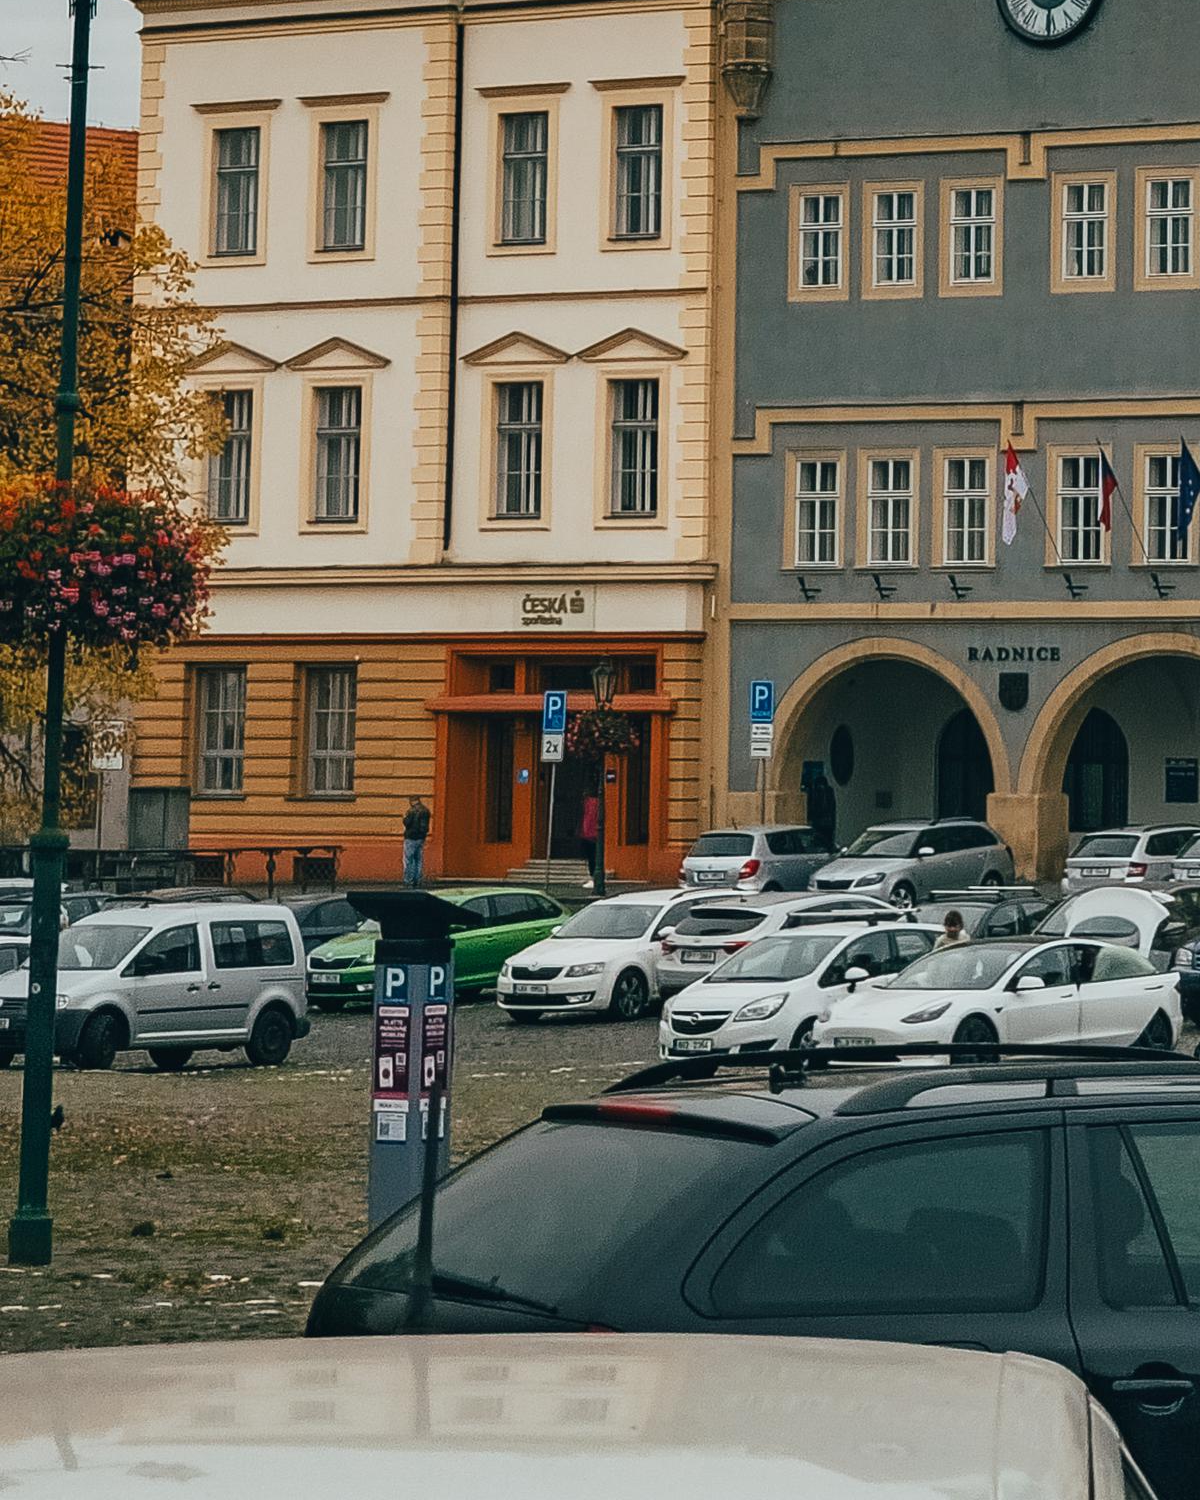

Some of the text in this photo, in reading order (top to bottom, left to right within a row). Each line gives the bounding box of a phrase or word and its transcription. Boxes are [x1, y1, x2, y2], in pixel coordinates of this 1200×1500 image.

[522, 594, 568, 614] ČESKÁ
[967, 646, 1061, 662] RADNICE
[548, 696, 562, 720] P
[755, 685, 769, 709] P
[545, 740, 559, 753] 2x
[385, 967, 405, 998] P
[430, 966, 445, 997] P
